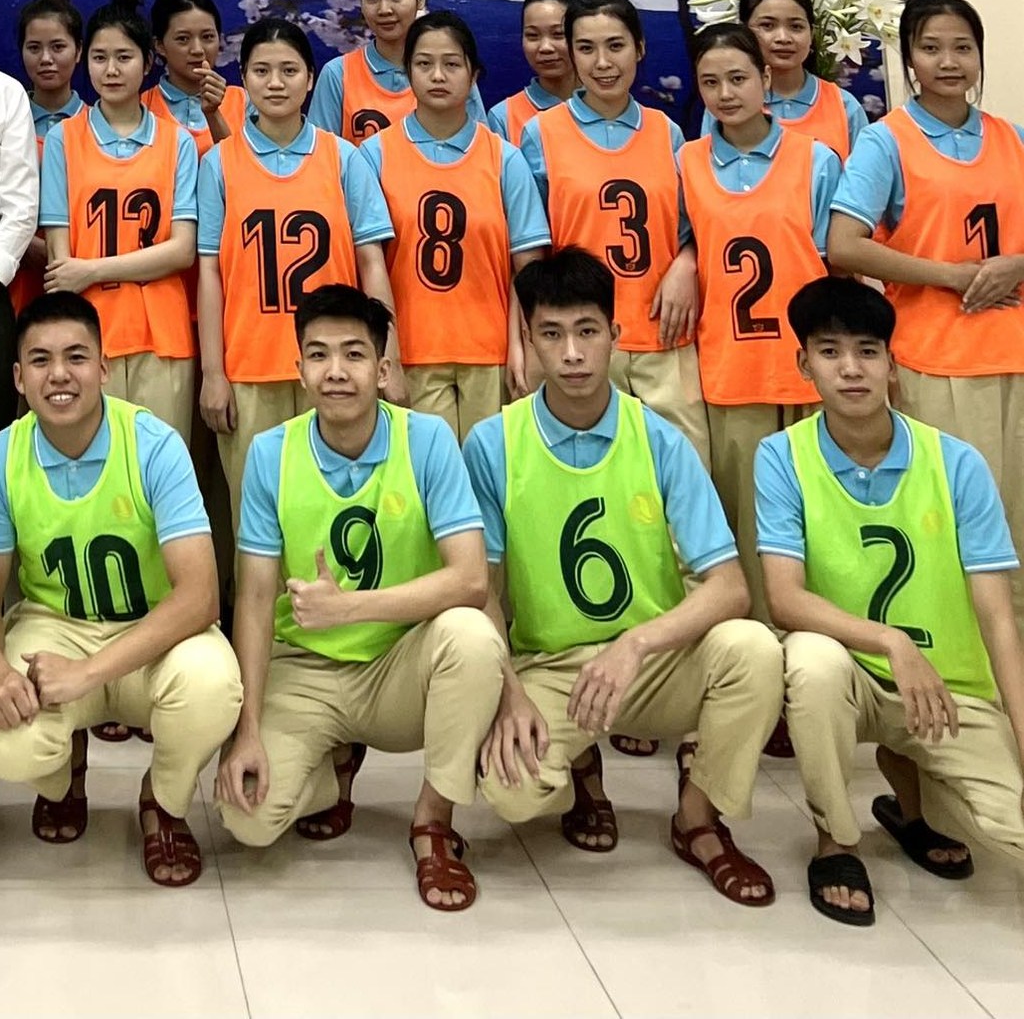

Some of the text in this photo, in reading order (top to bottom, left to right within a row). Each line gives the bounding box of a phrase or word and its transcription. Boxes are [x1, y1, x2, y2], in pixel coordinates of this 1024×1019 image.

[86, 188, 161, 290] 13
[241, 209, 331, 314] 12
[417, 190, 467, 292] 8
[599, 180, 650, 277] 3
[964, 203, 1001, 260] 1
[724, 237, 781, 340] 2
[40, 534, 148, 621] 10
[330, 505, 383, 590] 9
[559, 497, 634, 621] 6
[860, 525, 933, 649] 2
